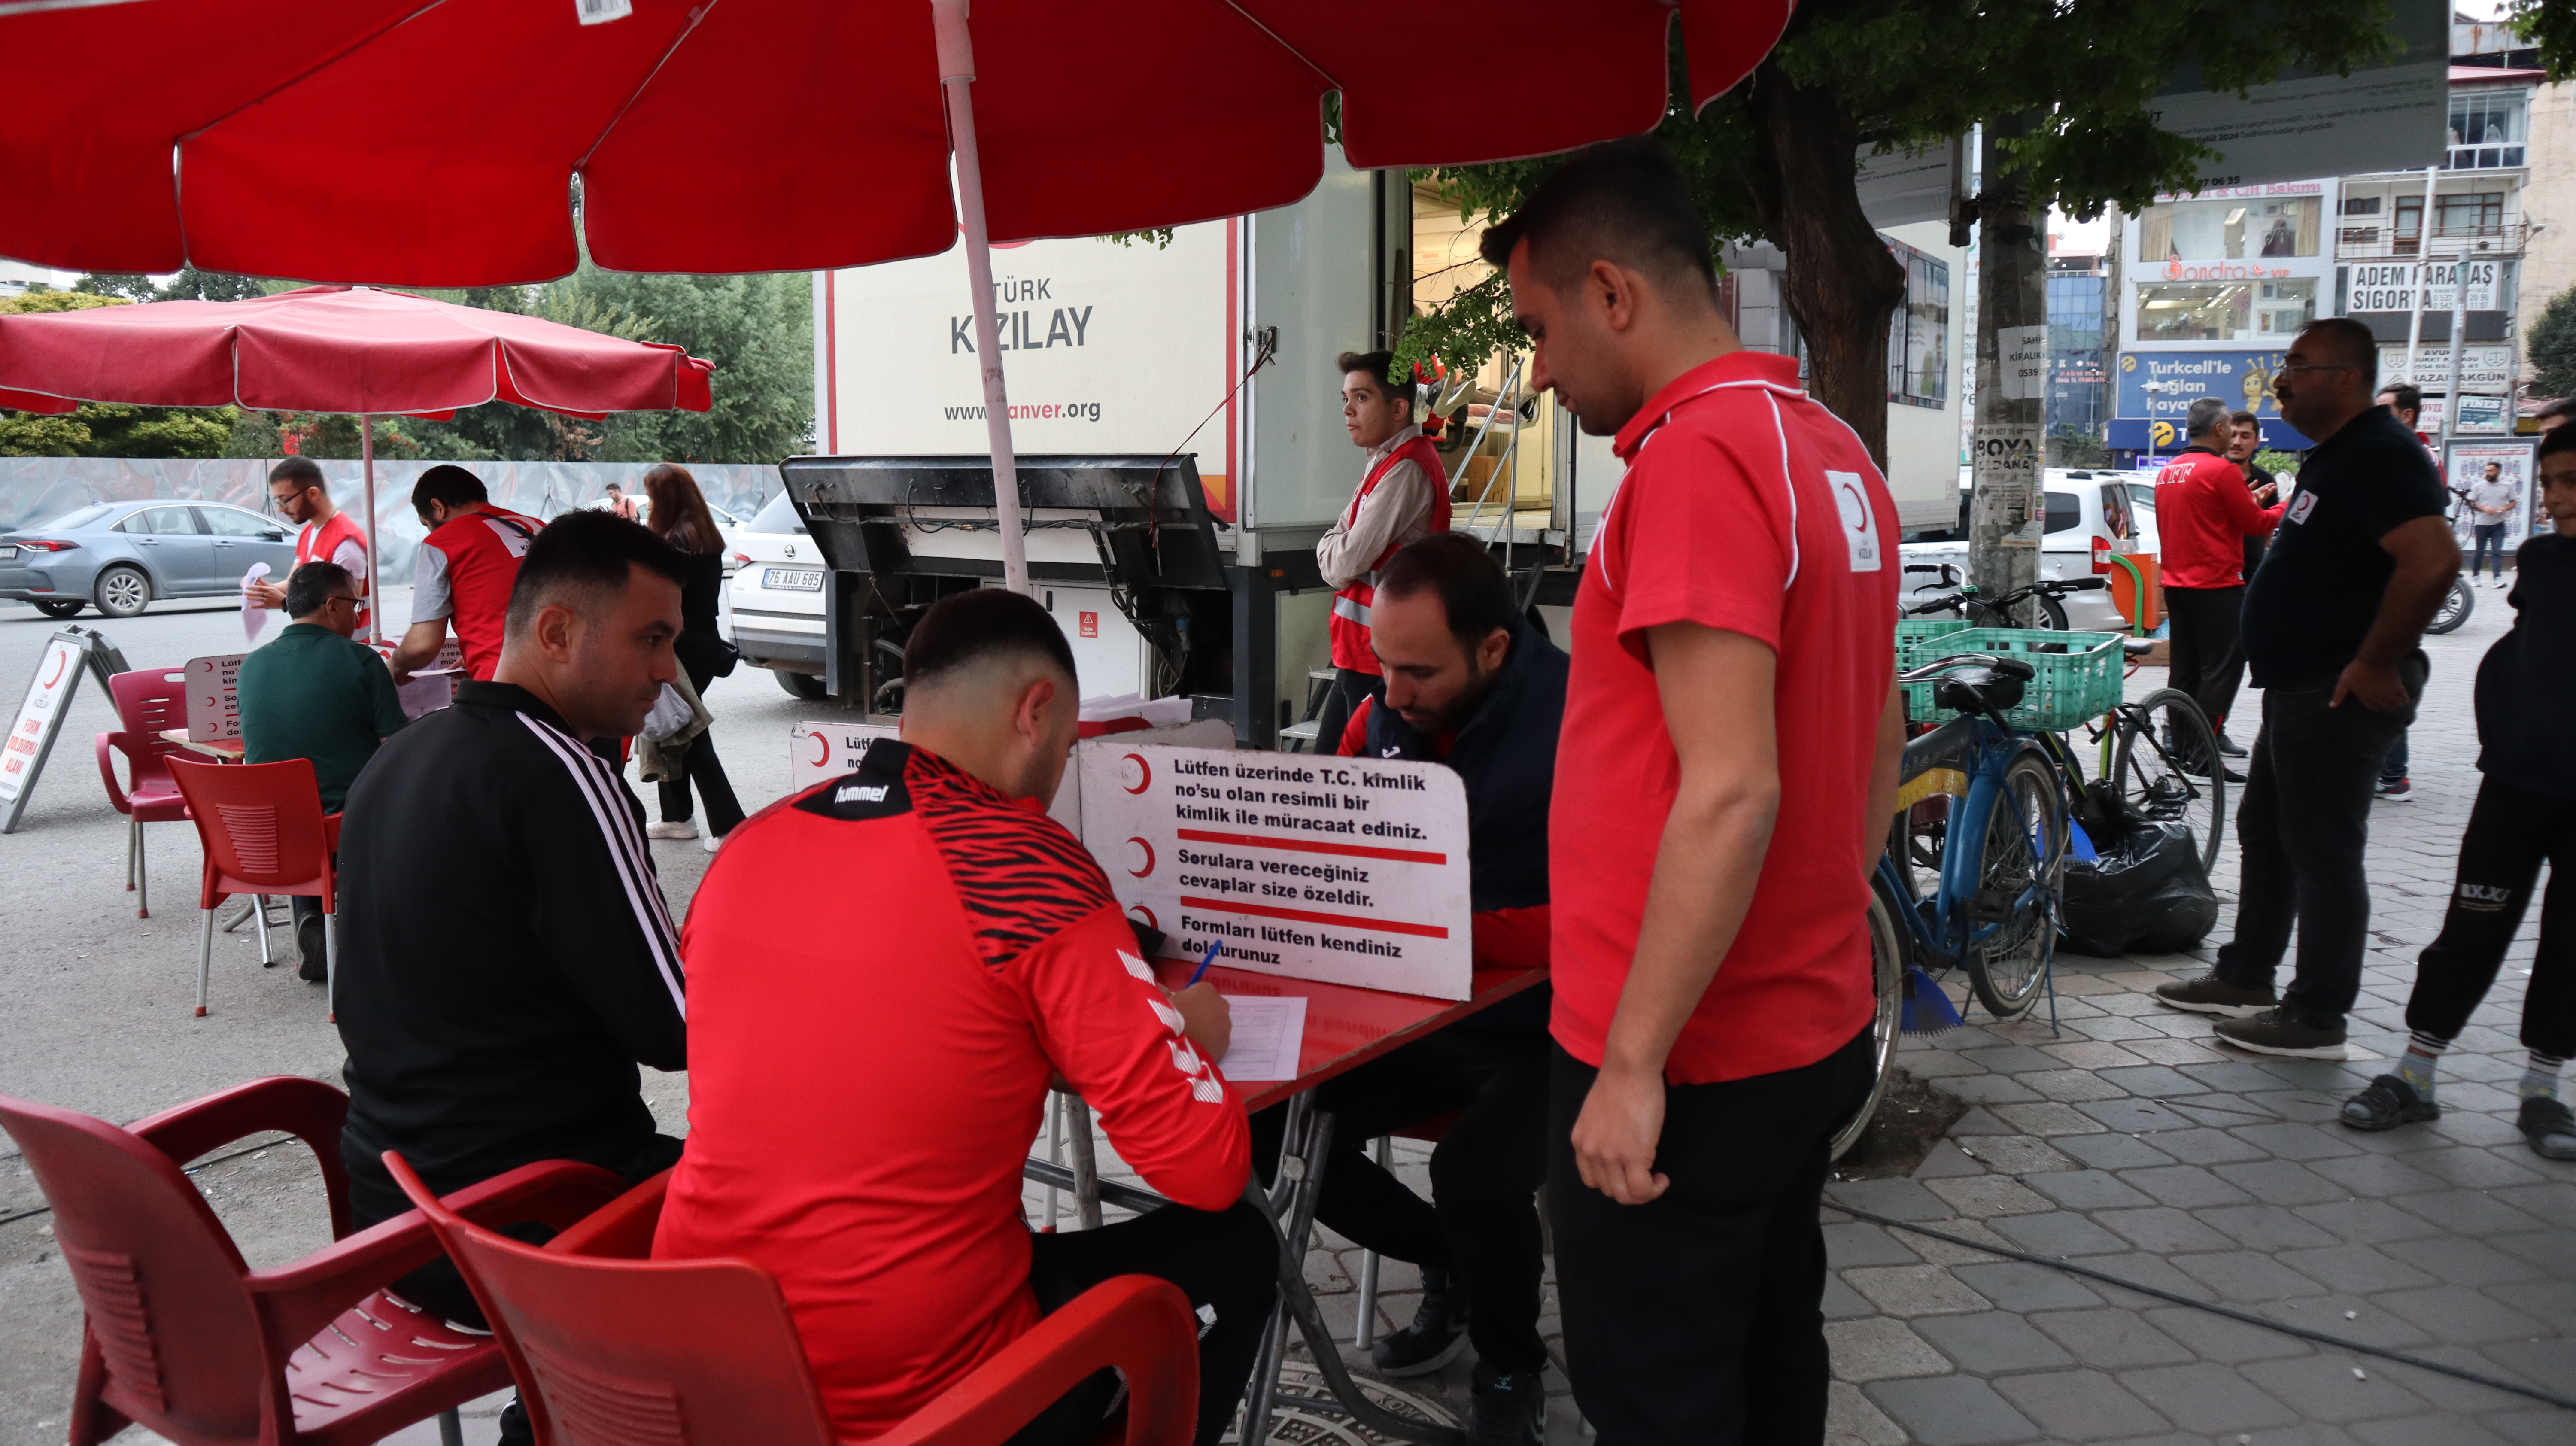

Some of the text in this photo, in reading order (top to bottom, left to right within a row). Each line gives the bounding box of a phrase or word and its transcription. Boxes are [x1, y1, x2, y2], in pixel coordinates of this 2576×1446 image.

[2218, 132, 2239, 141] 2024
[2211, 177, 2225, 186] 06
[2227, 175, 2241, 185] 35
[2162, 253, 2247, 281] Sandra
[2356, 264, 2494, 287] ADEM ARAAŞ
[993, 275, 1051, 304] TÜRK
[951, 305, 1094, 354] KZILAY
[2018, 368, 2038, 377] 0539
[2148, 360, 2232, 374] Turkcell'le
[2459, 371, 2506, 381] AKGÜN
[944, 401, 1100, 422] wwwanver.org
[2418, 401, 2443, 413] ÖVİZ
[2156, 462, 2196, 485] TFF
[768, 571, 820, 586] 76 AAU 685
[22, 717, 42, 735] FORM
[6, 735, 39, 758] DOLDURMA
[846, 736, 870, 750] Lütf
[4, 757, 25, 775] ALANI
[1175, 759, 1425, 791] Lütfen üzerinde T.C. kimlik
[834, 785, 889, 804] hummel
[1176, 783, 1370, 811] no'su olan resimli bir
[1176, 804, 1428, 840] kimlik ile müracaat ediniz.
[1179, 849, 1369, 883] Sorulara vereceğiniz
[1179, 875, 1374, 907] cevaplar size özeldir.
[1182, 915, 1402, 958] Formları lütfen kendiniz
